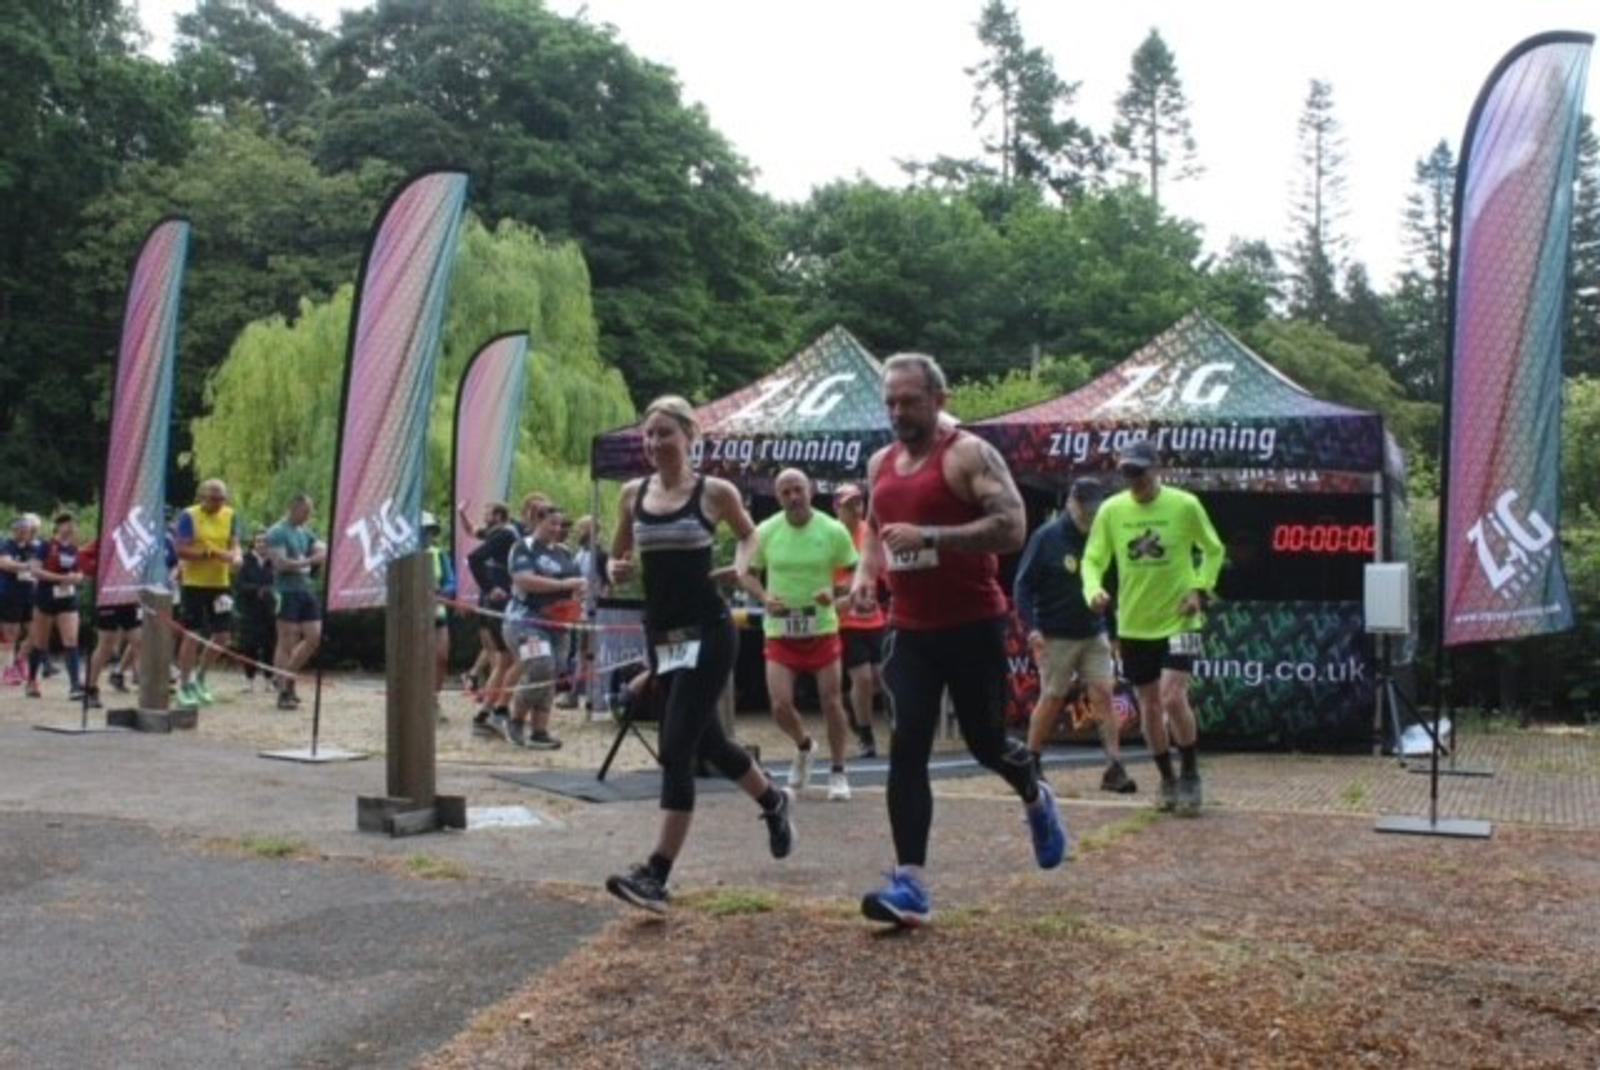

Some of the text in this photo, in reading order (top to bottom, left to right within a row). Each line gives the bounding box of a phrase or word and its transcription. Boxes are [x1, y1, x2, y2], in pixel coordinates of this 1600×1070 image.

[709, 438, 753, 468] zag
[759, 433, 862, 470] running
[1047, 425, 1090, 464] zig
[1155, 420, 1277, 461] running
[1273, 524, 1375, 552] 00:00:00
